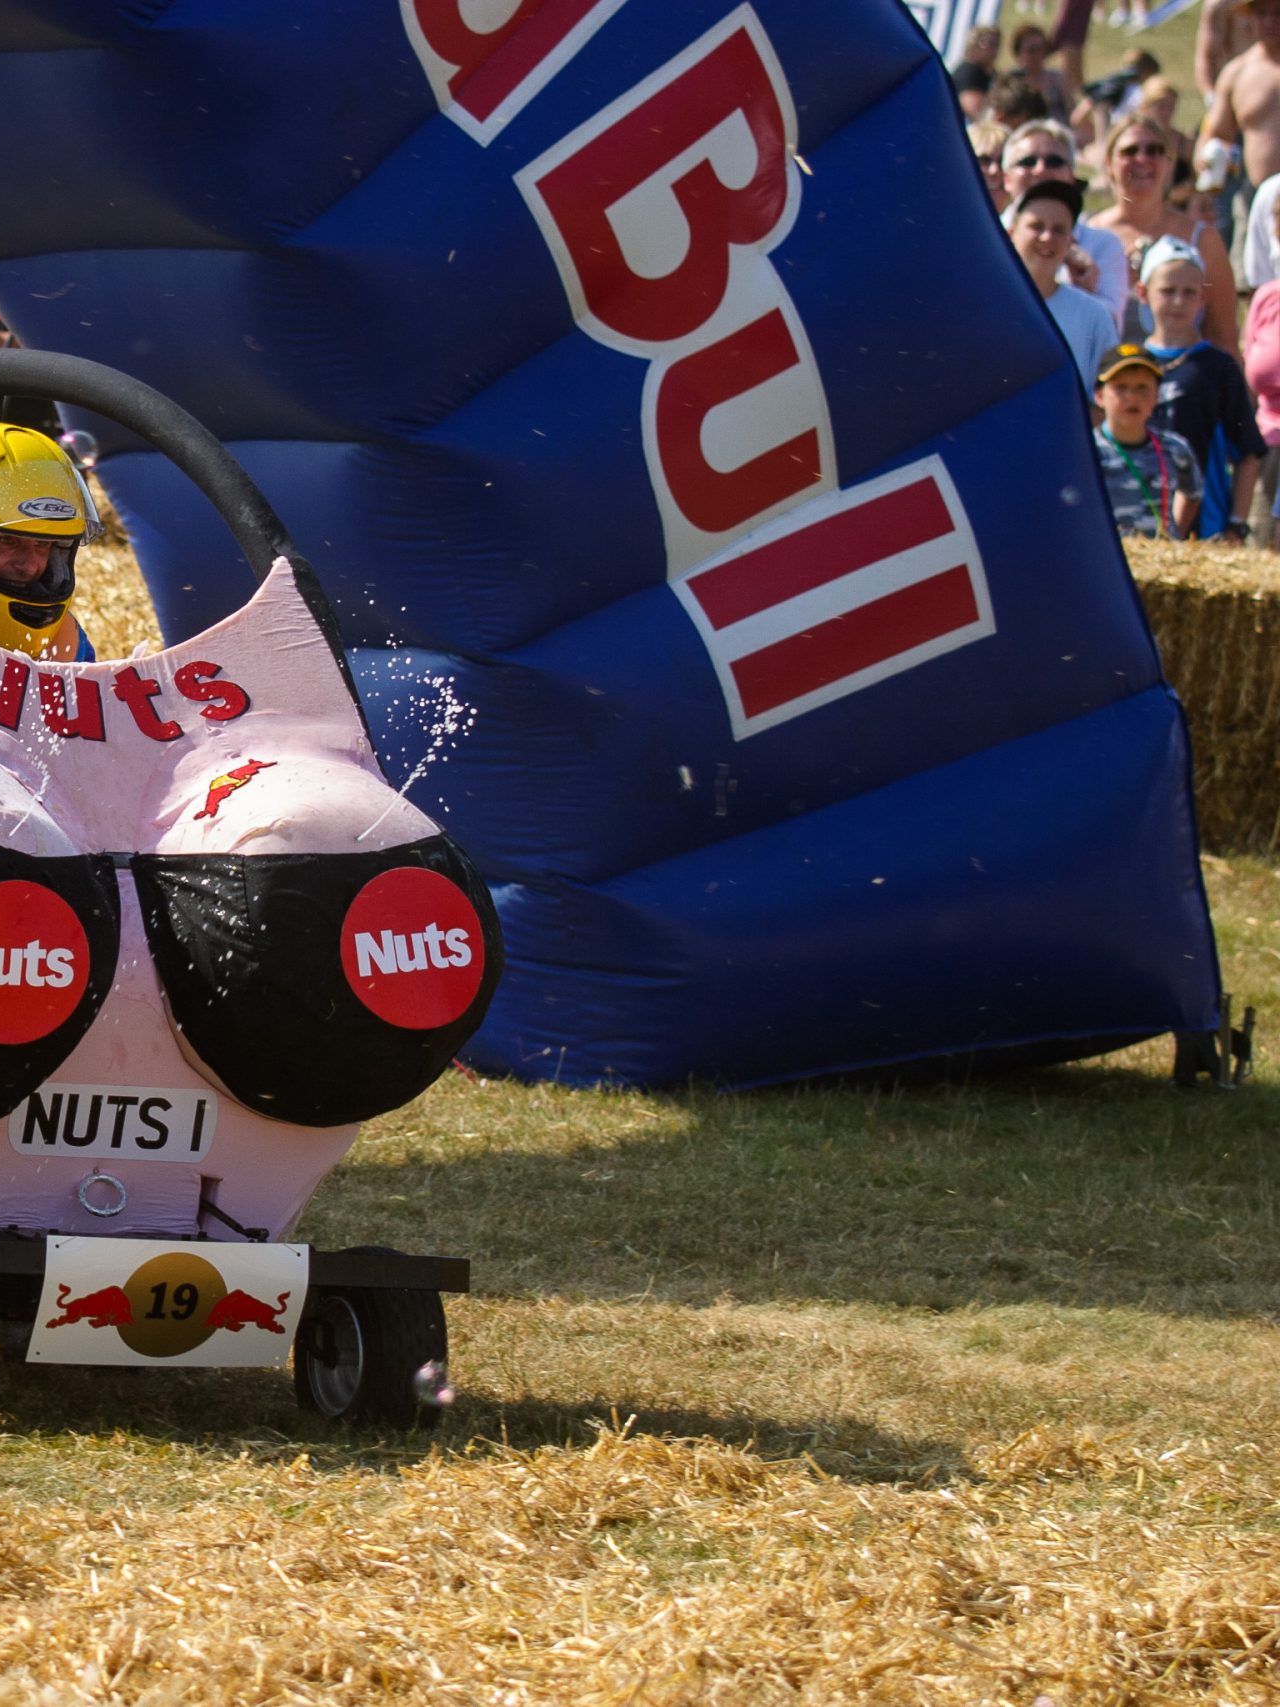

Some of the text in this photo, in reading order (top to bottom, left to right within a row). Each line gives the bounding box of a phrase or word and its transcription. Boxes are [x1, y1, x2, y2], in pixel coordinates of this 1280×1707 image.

[530, 20, 985, 725] Bull
[24, 502, 73, 513] KBC
[354, 922, 472, 977] Nuts
[22, 1092, 173, 1150] NUTS
[145, 1282, 199, 1319] 19
